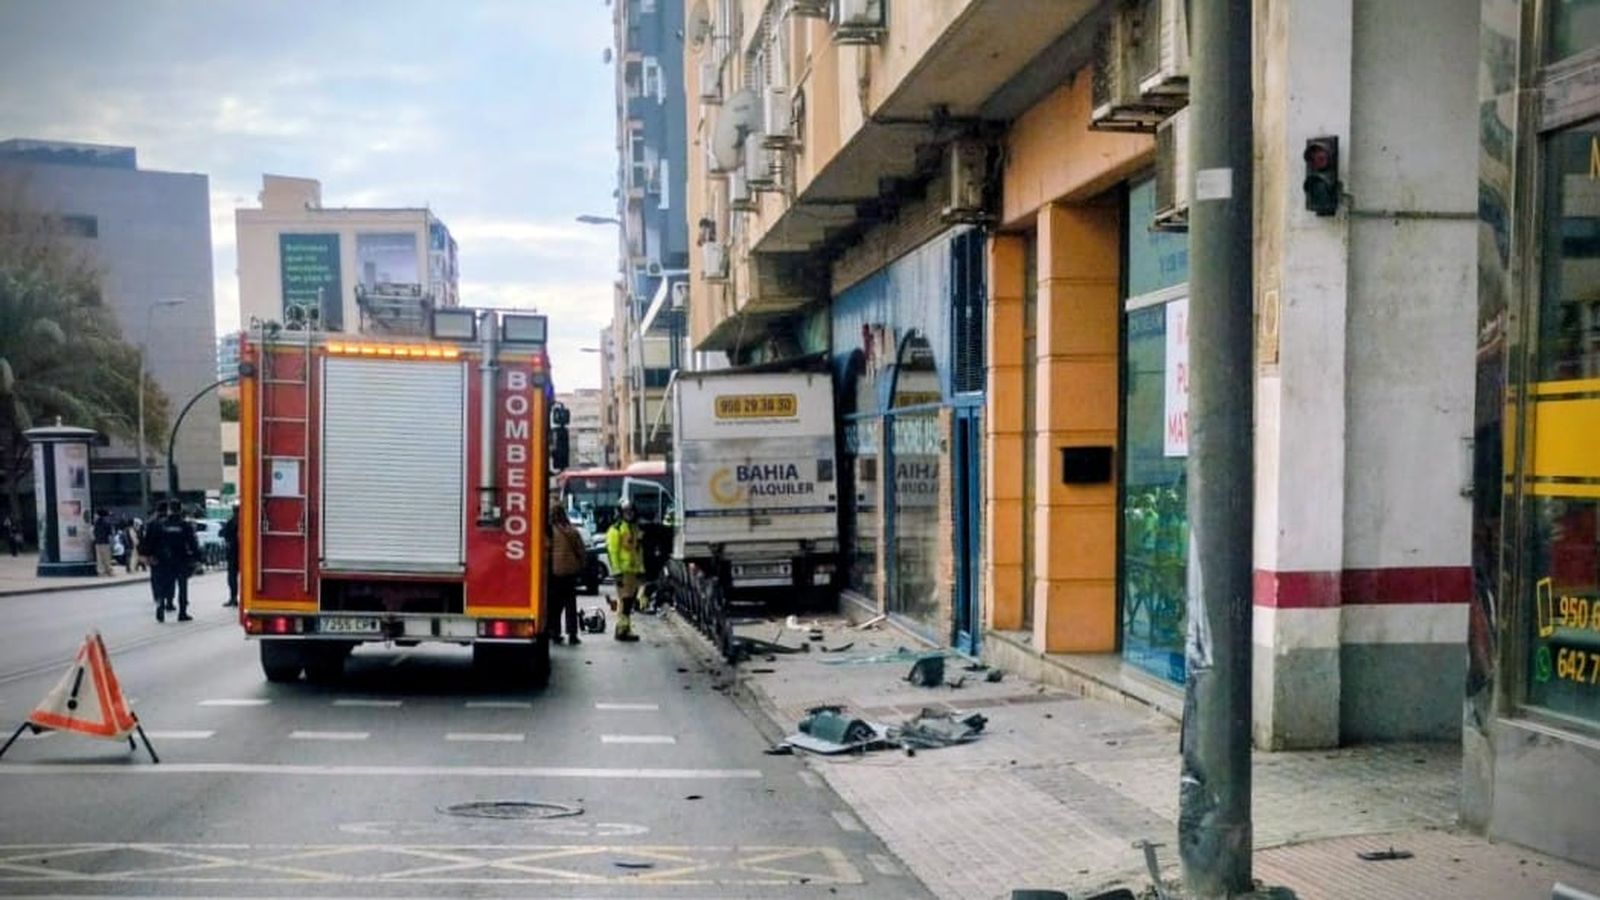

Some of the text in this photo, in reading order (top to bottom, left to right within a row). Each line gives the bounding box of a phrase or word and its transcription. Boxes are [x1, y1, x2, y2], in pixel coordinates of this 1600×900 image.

[505, 371, 529, 561] BOMBEROS
[736, 463, 799, 482] BAHIA
[749, 481, 814, 497] ALQUILER
[1559, 596, 1588, 629] 950
[1557, 647, 1586, 683] 642
